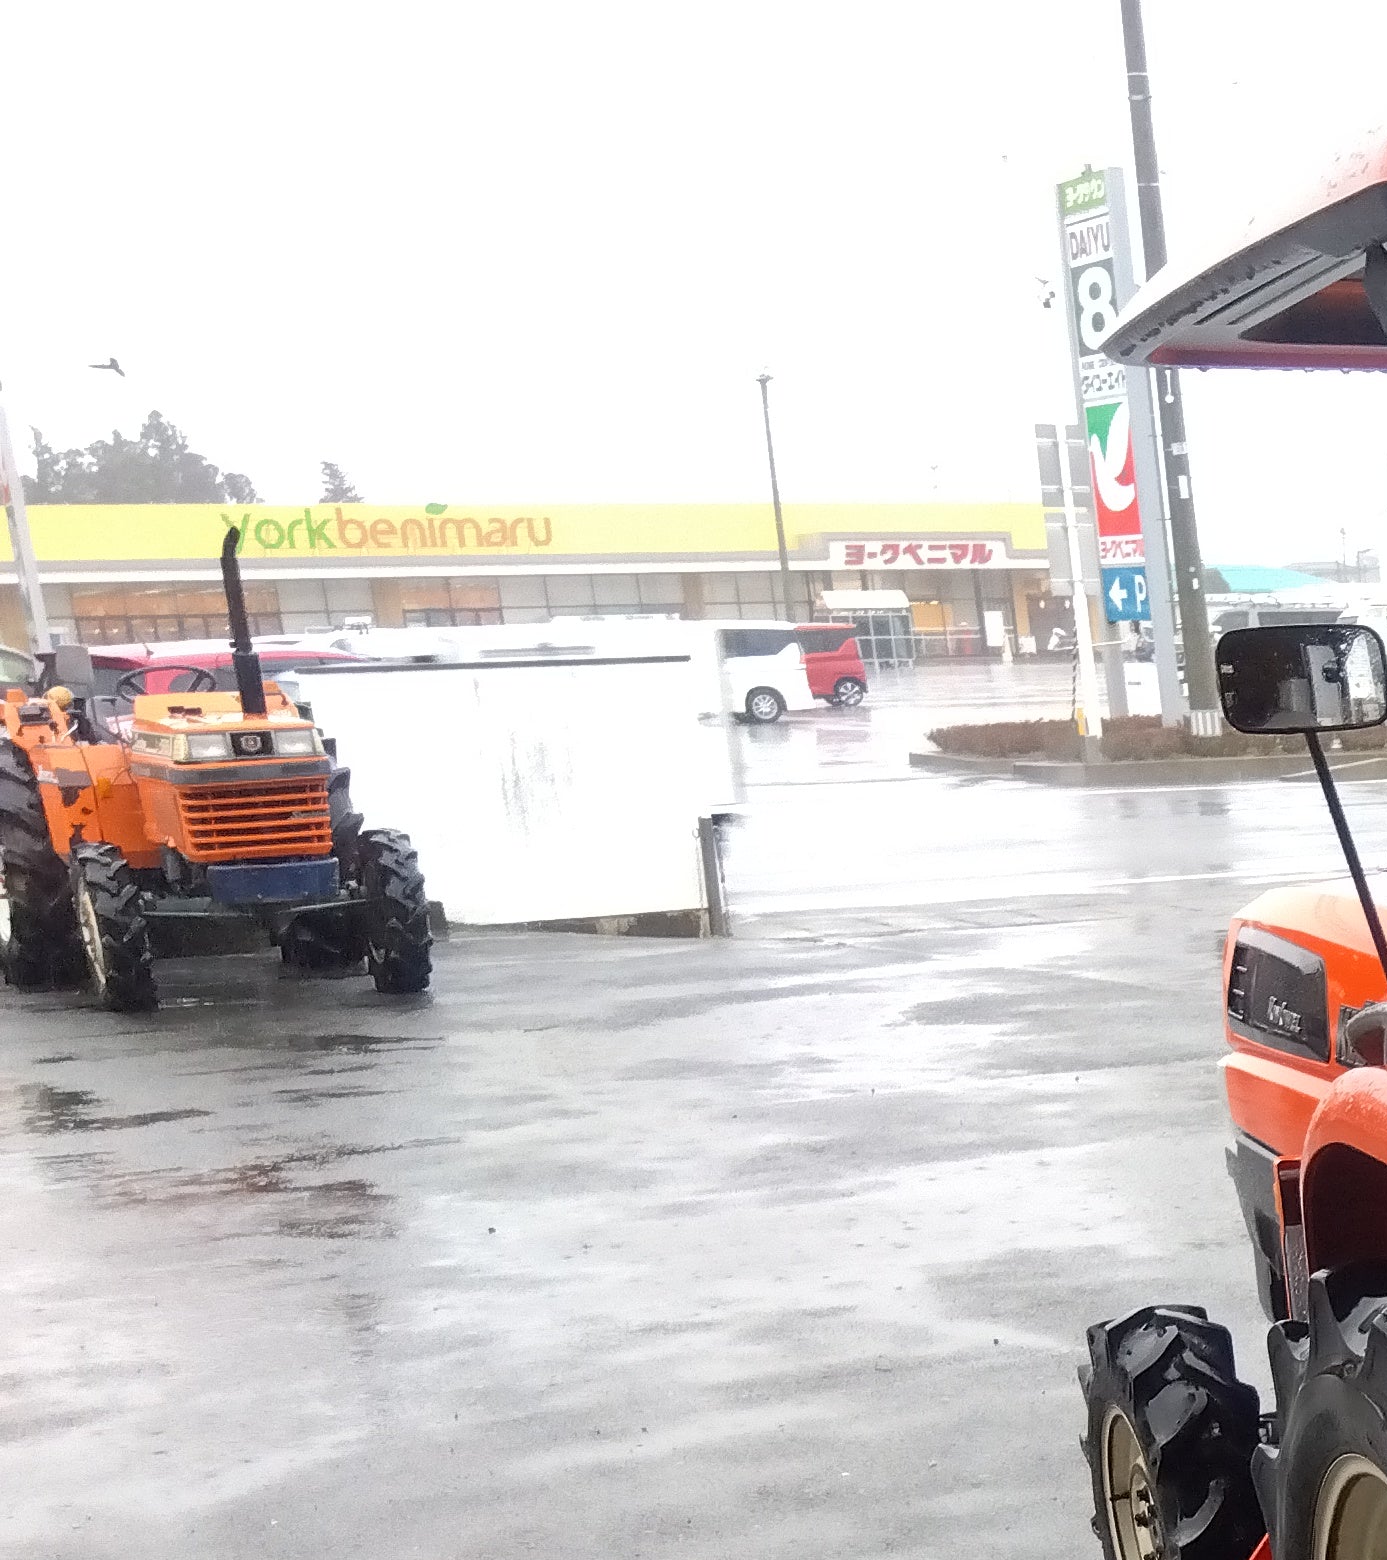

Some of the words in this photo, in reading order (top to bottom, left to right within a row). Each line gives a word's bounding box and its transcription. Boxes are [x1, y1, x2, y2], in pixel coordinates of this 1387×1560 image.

[1069, 222, 1110, 261] DAIYU
[1077, 266, 1118, 350] 8
[1134, 574, 1147, 613] P
